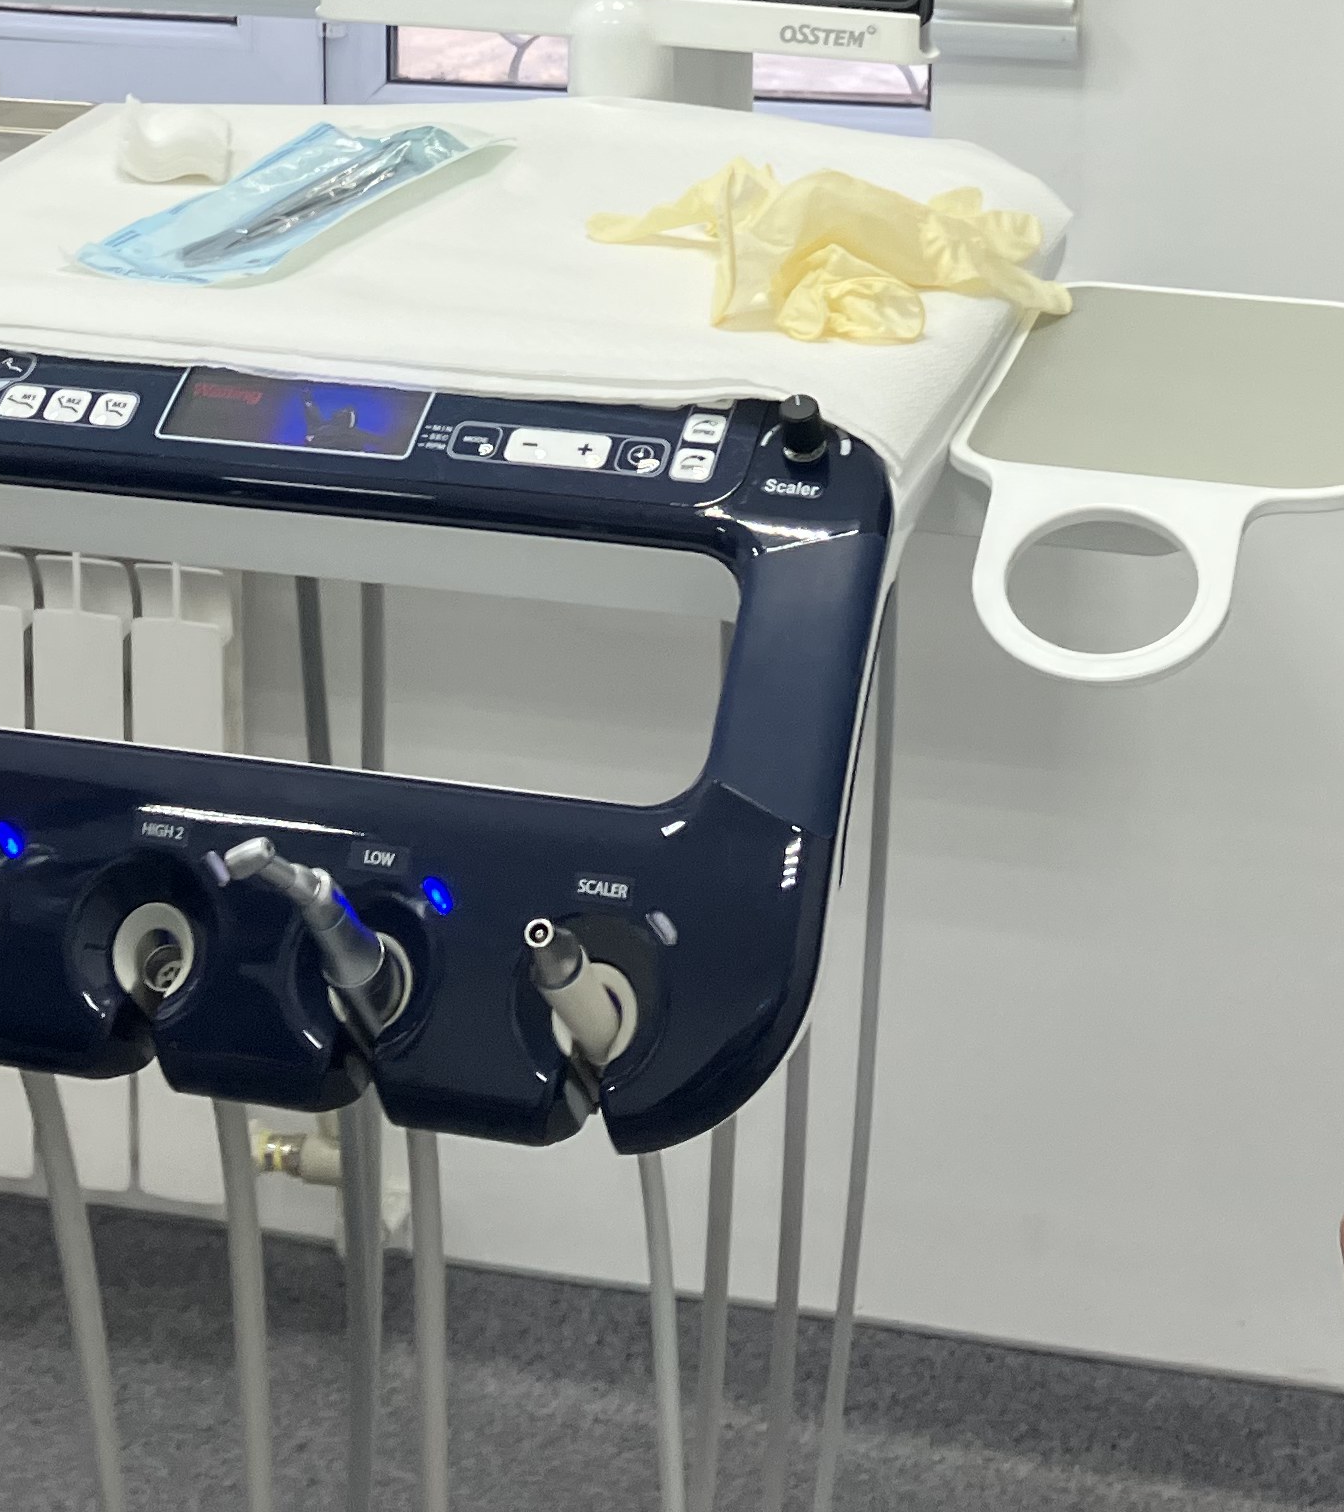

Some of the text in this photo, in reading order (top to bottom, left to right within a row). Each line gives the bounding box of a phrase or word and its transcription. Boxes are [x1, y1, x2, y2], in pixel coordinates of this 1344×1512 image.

[780, 24, 866, 48] OSSTEM
[764, 478, 820, 496] Scaler
[141, 822, 185, 840] HIGH 2
[364, 850, 396, 867] LOW
[577, 878, 629, 900] SCALER
